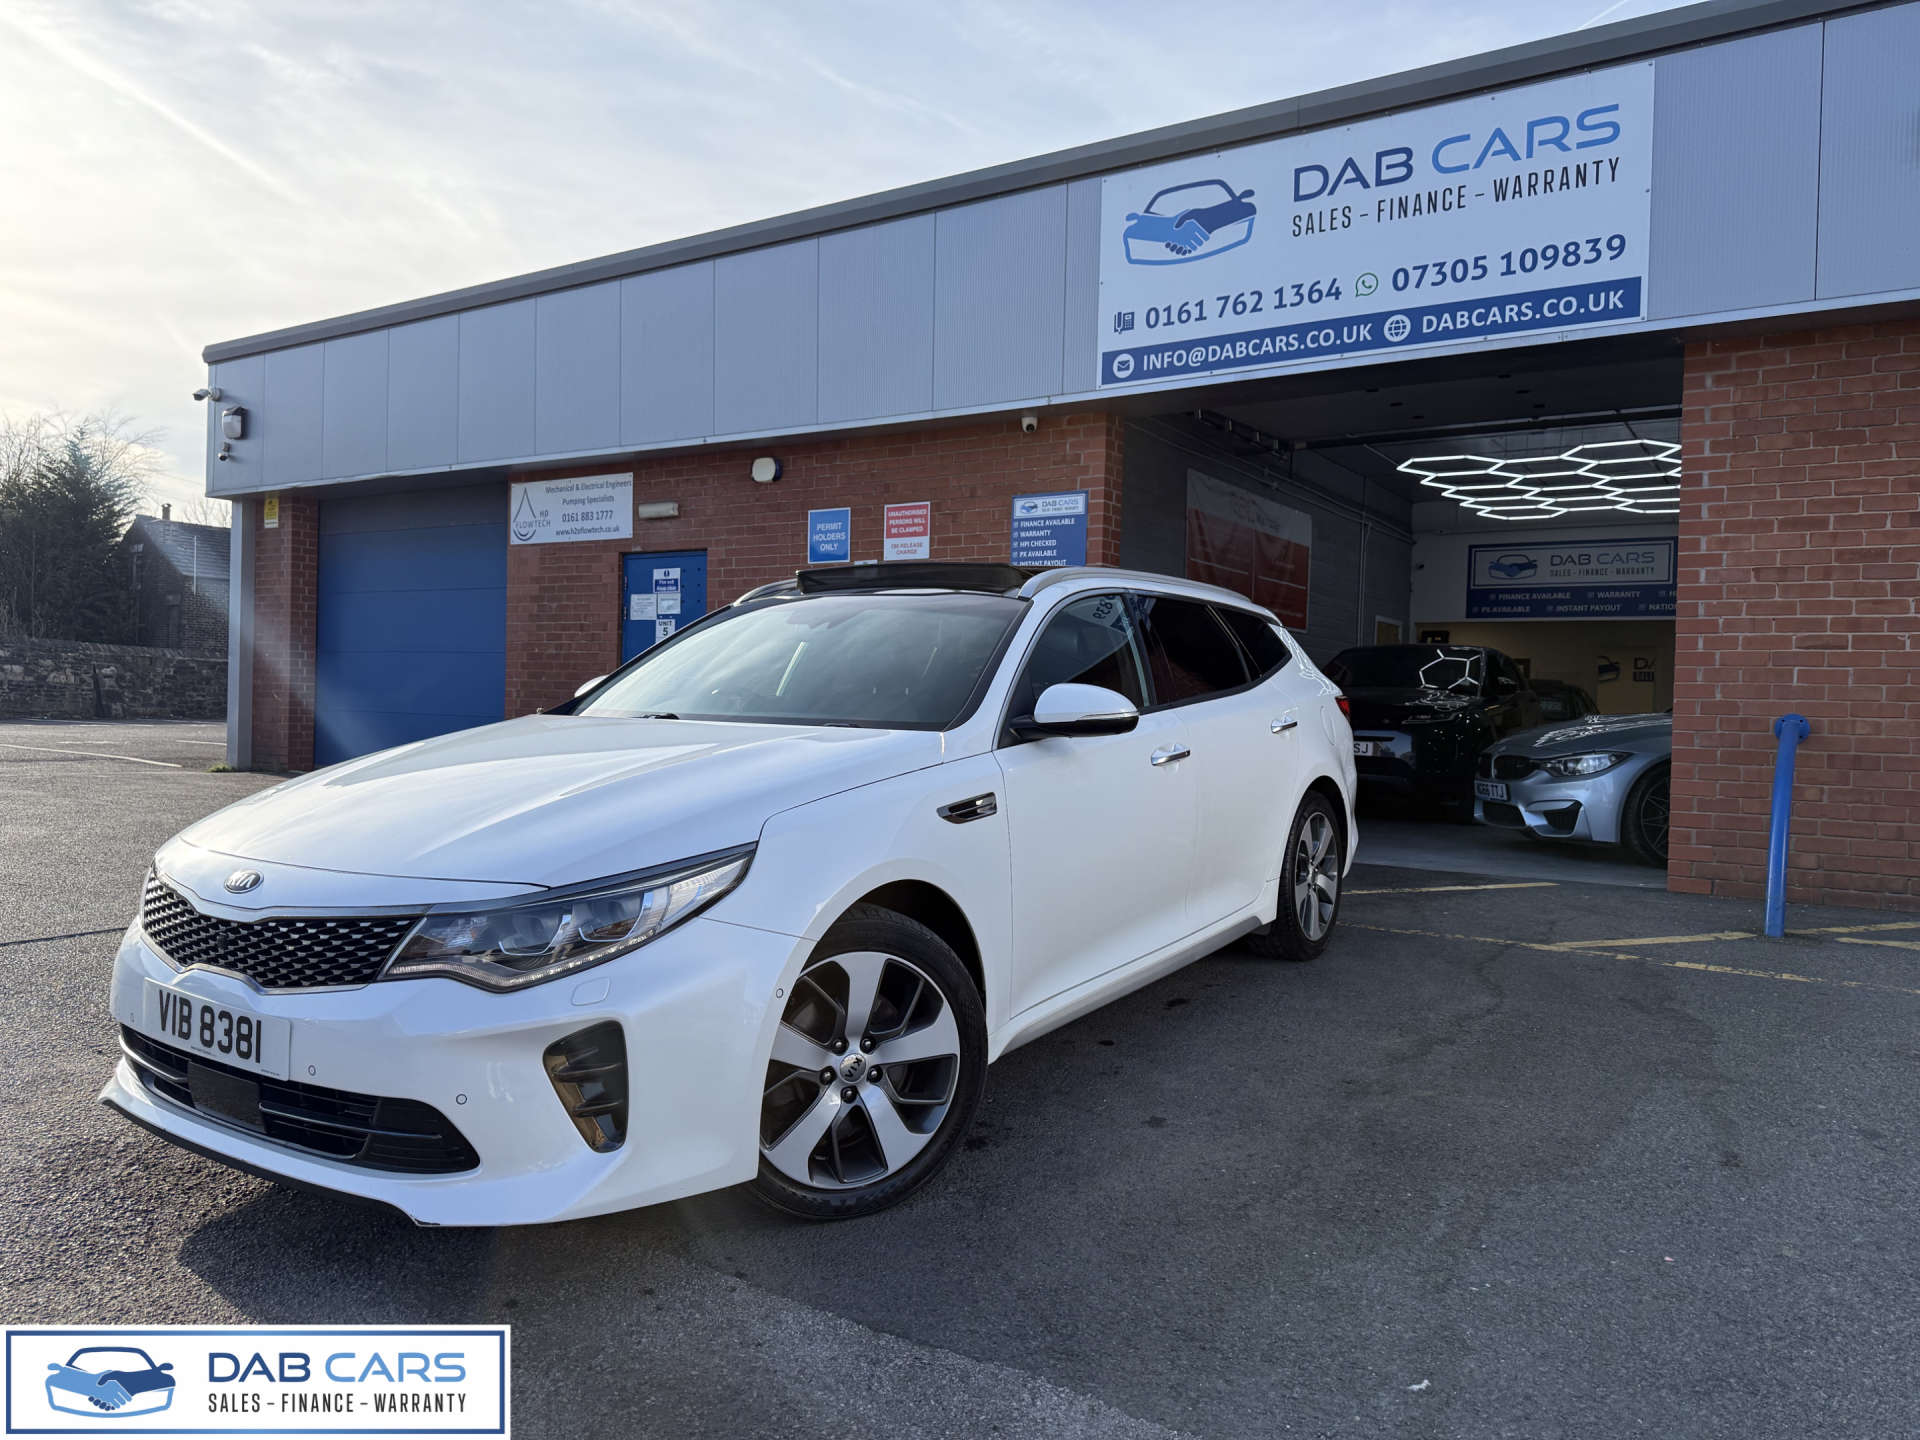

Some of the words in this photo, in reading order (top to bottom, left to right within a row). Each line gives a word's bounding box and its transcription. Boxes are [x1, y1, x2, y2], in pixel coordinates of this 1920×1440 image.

[1293, 146, 1414, 202] DAB
[1431, 103, 1621, 175] CARS
[1292, 205, 1352, 238] SALES
[1377, 185, 1466, 223] FINANCE
[1493, 156, 1620, 203] WARRANTY
[1392, 254, 1488, 292] 07305
[1500, 233, 1626, 277] 109839
[1145, 299, 1207, 329] 0161
[1216, 289, 1264, 319] 762
[1273, 278, 1342, 310] 1364
[1422, 289, 1624, 334] DABCARS.CO.UK
[1142, 322, 1372, 372] INFO@DABCARS.CO.UK
[545, 484, 575, 494] Mechanical
[580, 481, 604, 491] Electrical
[605, 480, 632, 490] Engineers
[562, 498, 586, 506] Pumping
[587, 495, 615, 504] Specialists
[1059, 497, 1078, 505] CARS
[562, 513, 578, 522] 0161
[581, 512, 594, 521] 883
[596, 510, 614, 520] 1777
[1045, 518, 1075, 526] AVAILABLE
[515, 520, 551, 529] FLOWTECH
[816, 522, 842, 531] PERMIT
[814, 532, 846, 541] HOLDERS
[820, 543, 839, 552] ONLY
[1551, 553, 1591, 567] DAB
[1597, 551, 1655, 565] CARS
[1578, 568, 1608, 576] FINANCE
[1616, 567, 1655, 576] WARRANTY
[663, 627, 669, 636] 5
[159, 989, 192, 1041] VIB
[200, 1004, 262, 1064] 8381
[845, 1057, 862, 1078] KIA
